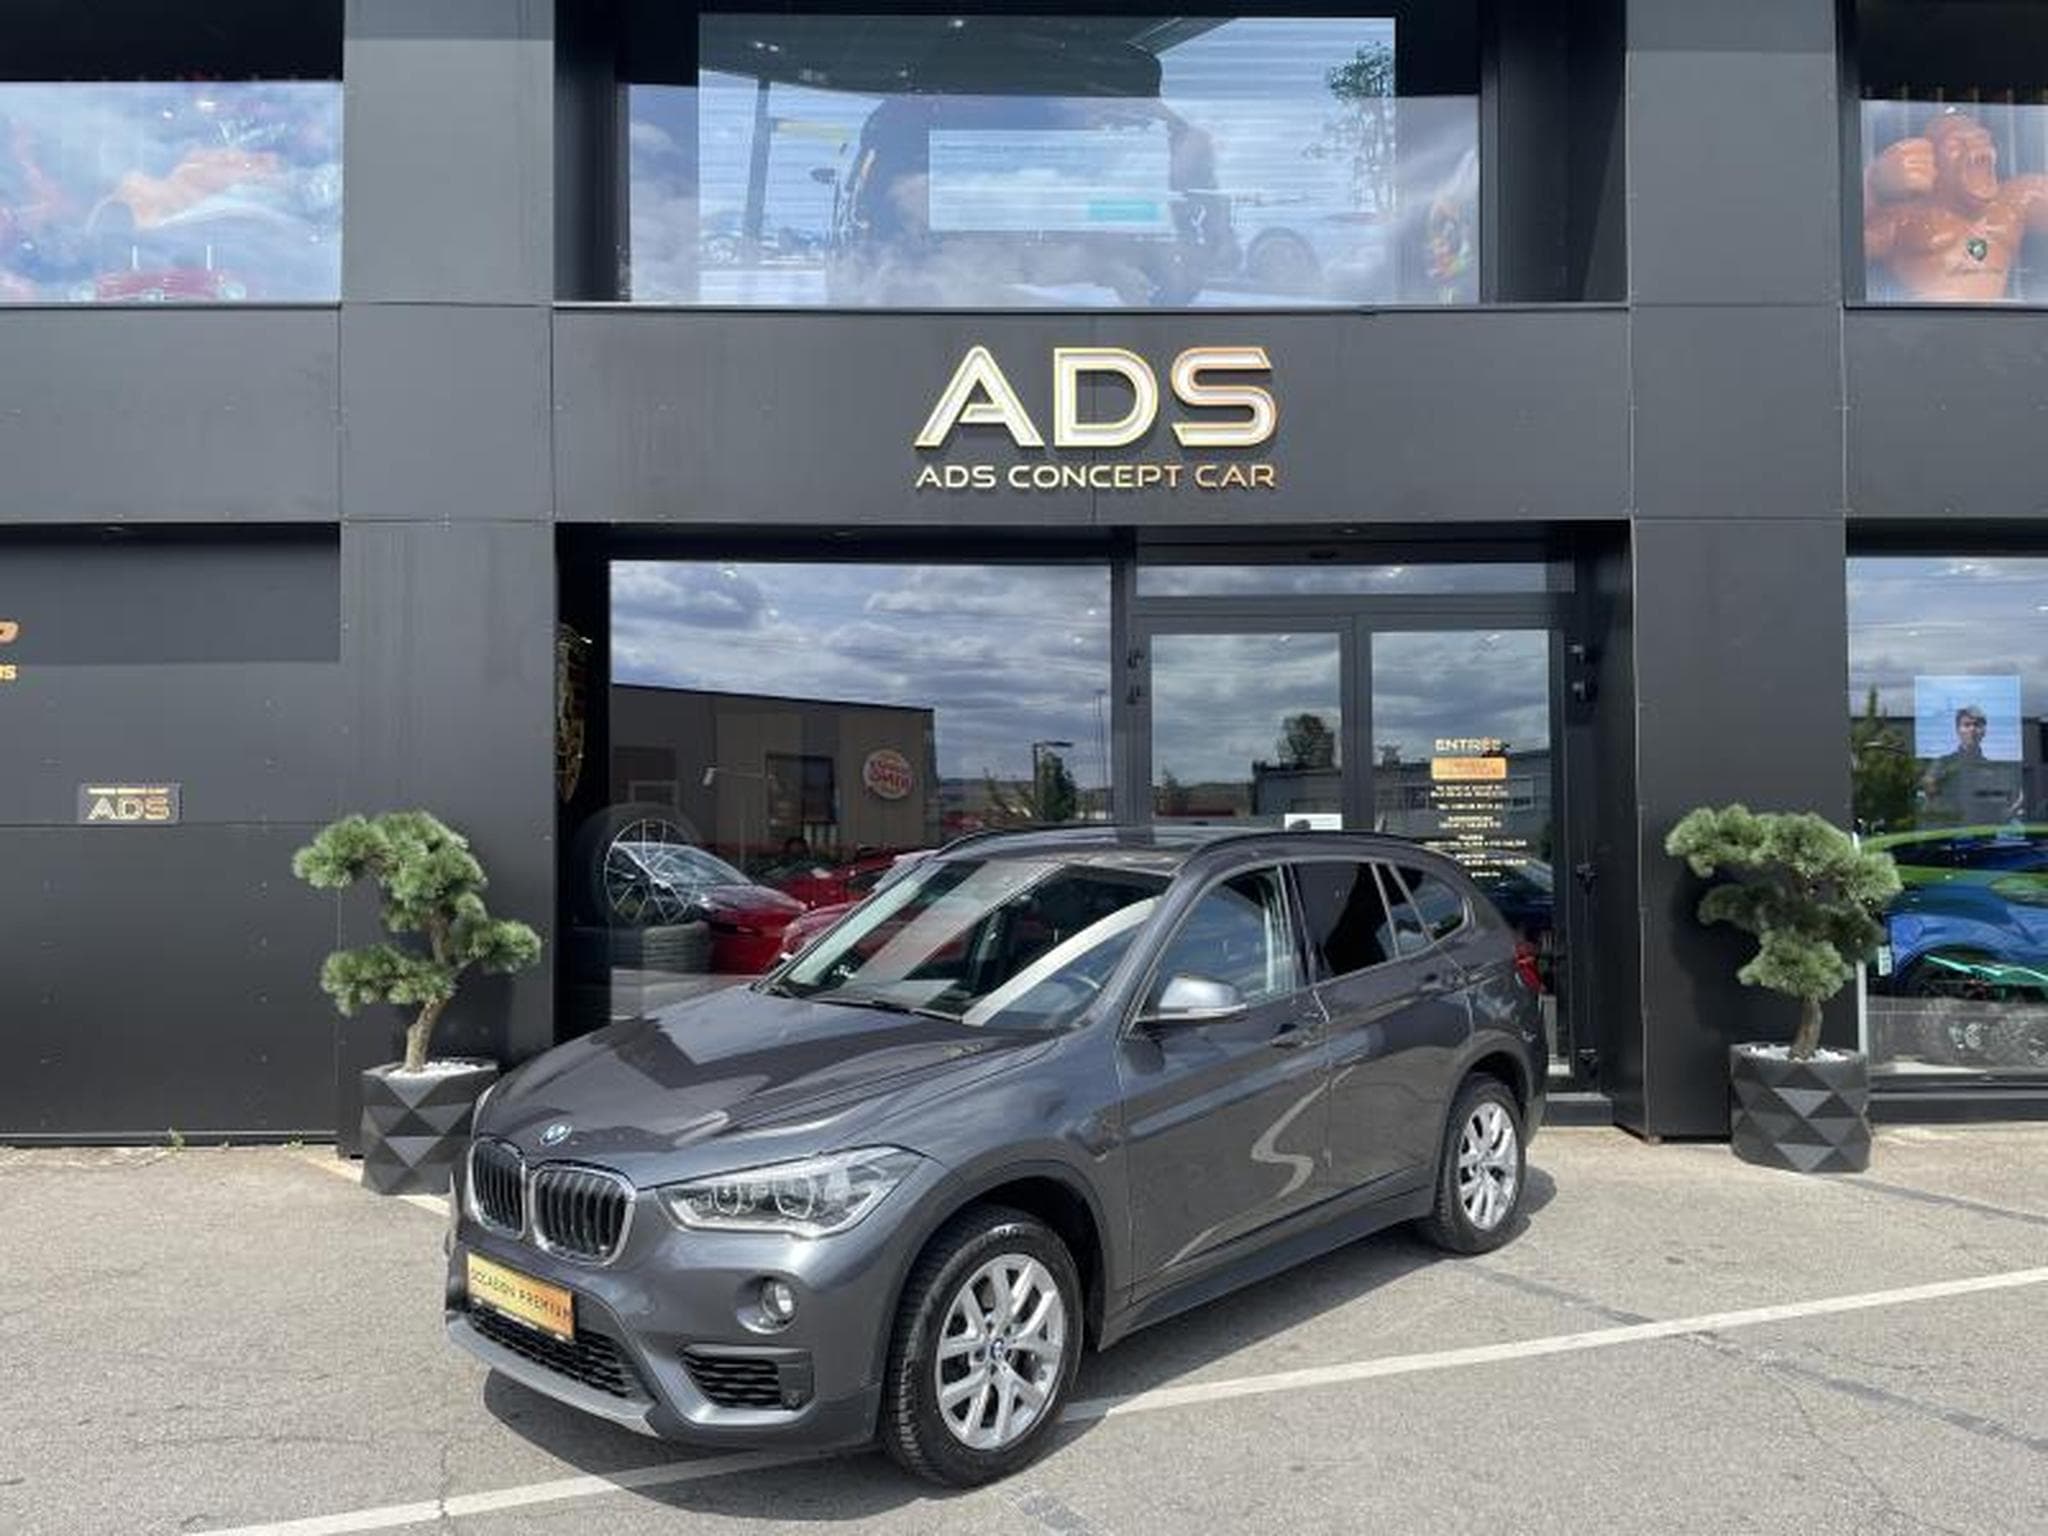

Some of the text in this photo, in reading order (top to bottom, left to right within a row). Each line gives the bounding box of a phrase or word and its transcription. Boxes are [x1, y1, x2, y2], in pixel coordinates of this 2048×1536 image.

[914, 344, 1277, 448] ADS
[915, 464, 1275, 489] ADS CONCEPT CAR
[87, 796, 170, 820] ADS
